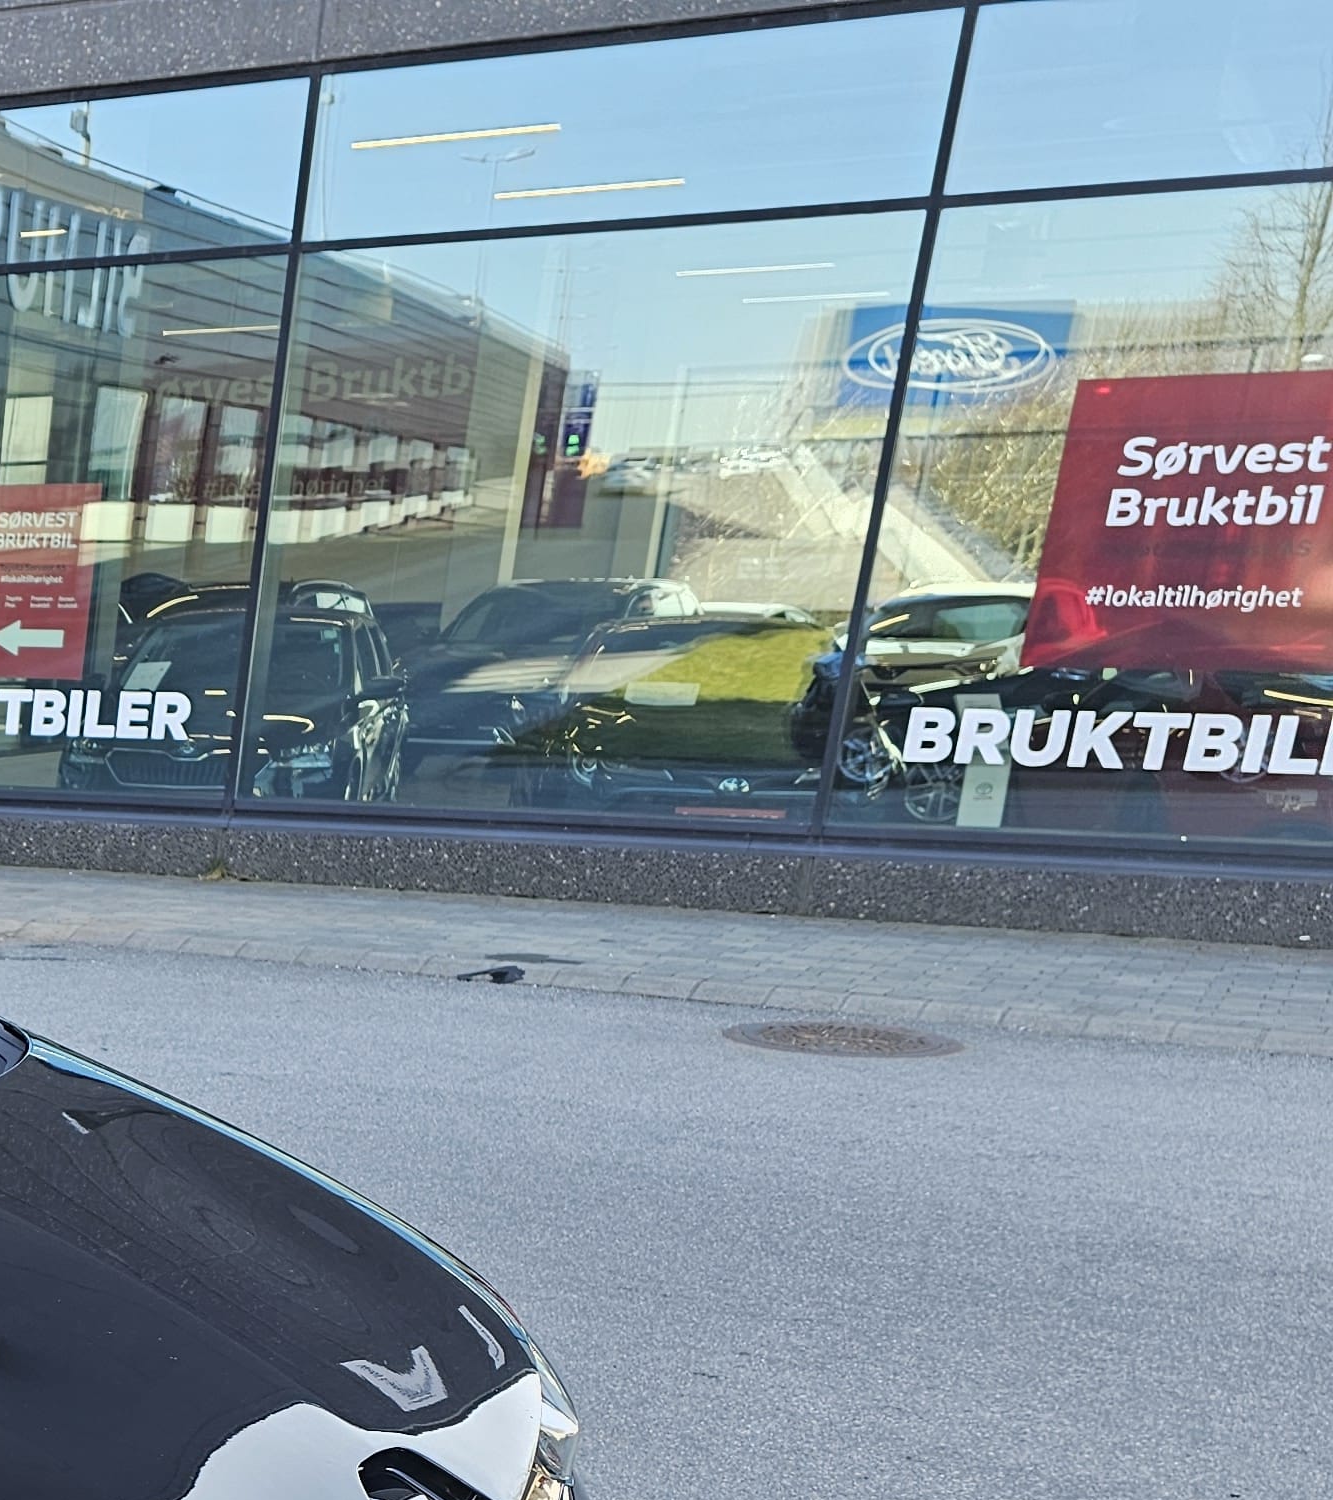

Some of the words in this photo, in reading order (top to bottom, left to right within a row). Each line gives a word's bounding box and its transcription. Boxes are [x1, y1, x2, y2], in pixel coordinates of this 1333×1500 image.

[1117, 435, 1332, 481] Sørvest
[1105, 484, 1325, 527] Bruktbil
[1085, 584, 1304, 613] #lokaltilhørighet
